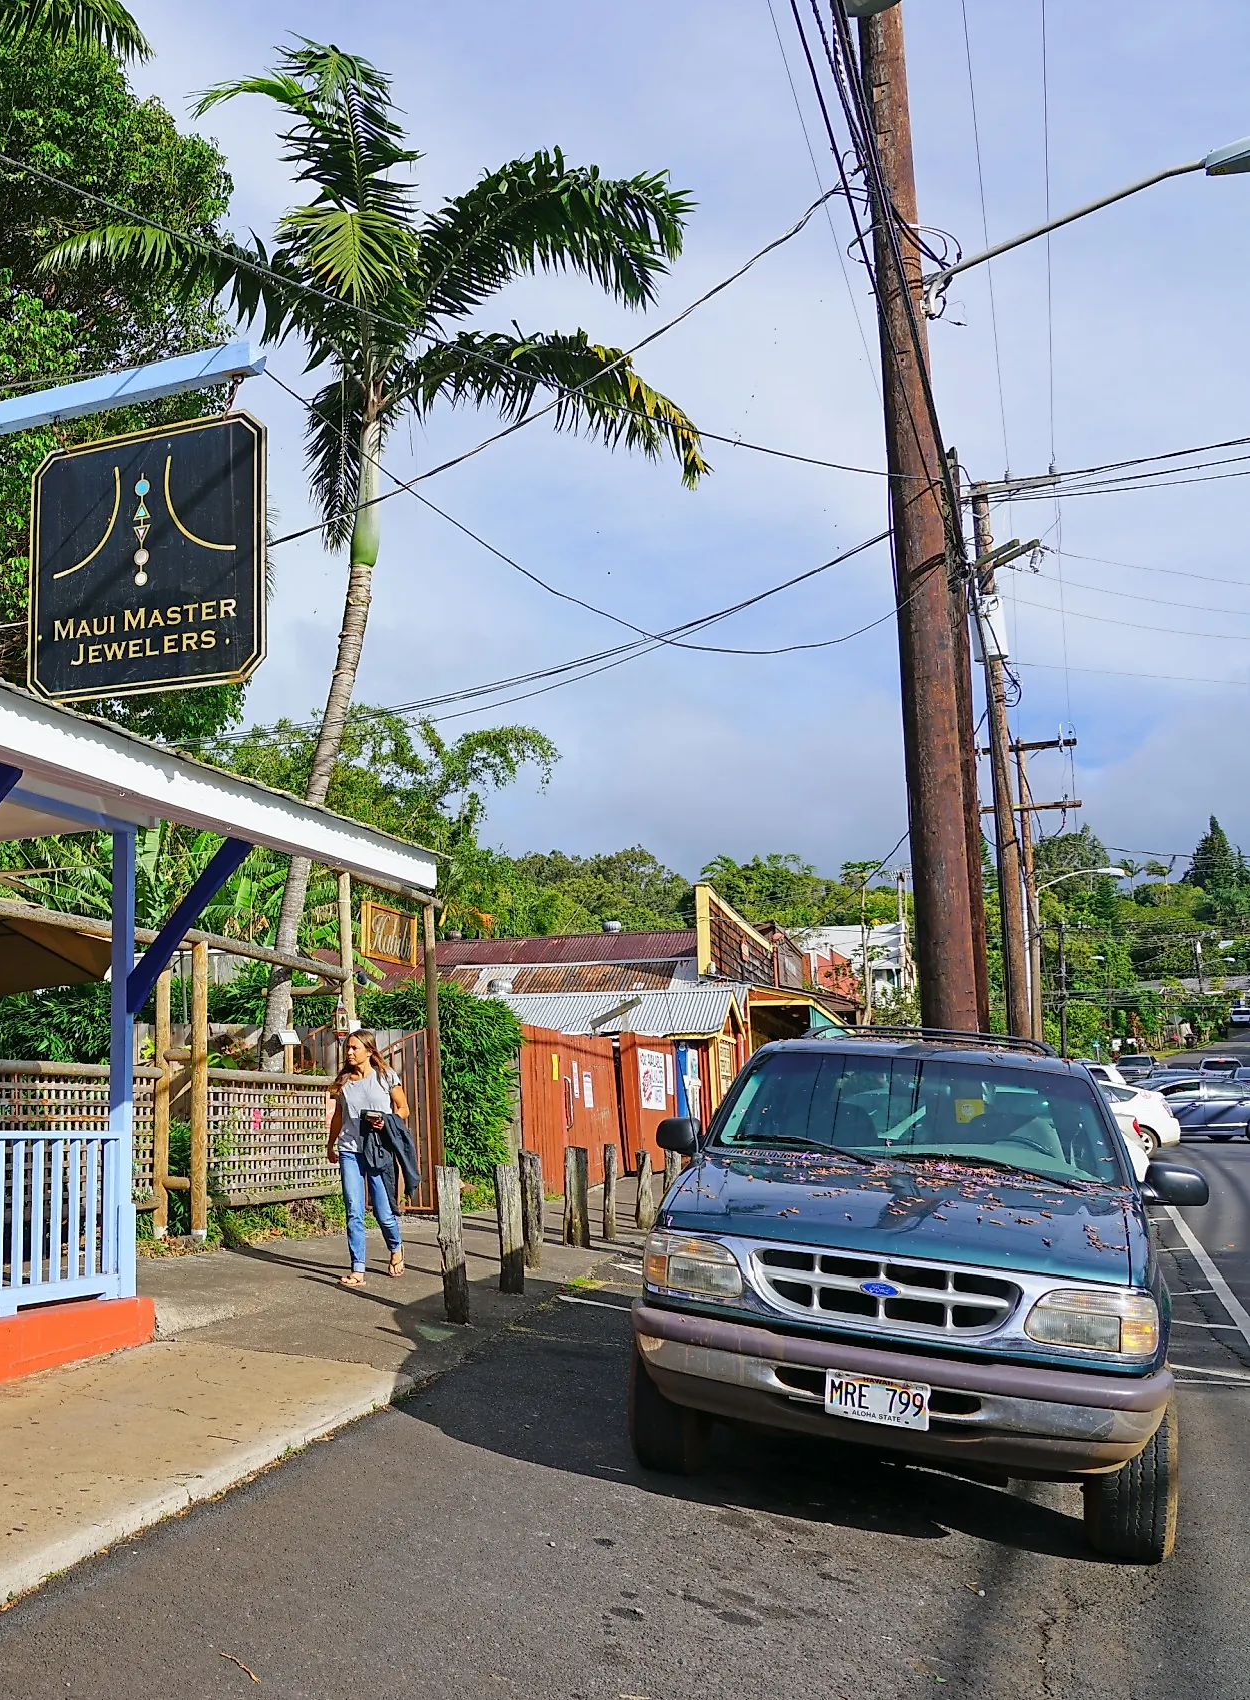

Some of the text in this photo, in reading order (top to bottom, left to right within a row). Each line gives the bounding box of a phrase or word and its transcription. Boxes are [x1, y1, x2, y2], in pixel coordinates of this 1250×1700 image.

[53, 598, 238, 642] MAUI MASTER
[70, 629, 217, 666] JEWELERS
[829, 1378, 925, 1418] MRE 799
[851, 1409, 901, 1423] ALOHA STATE
